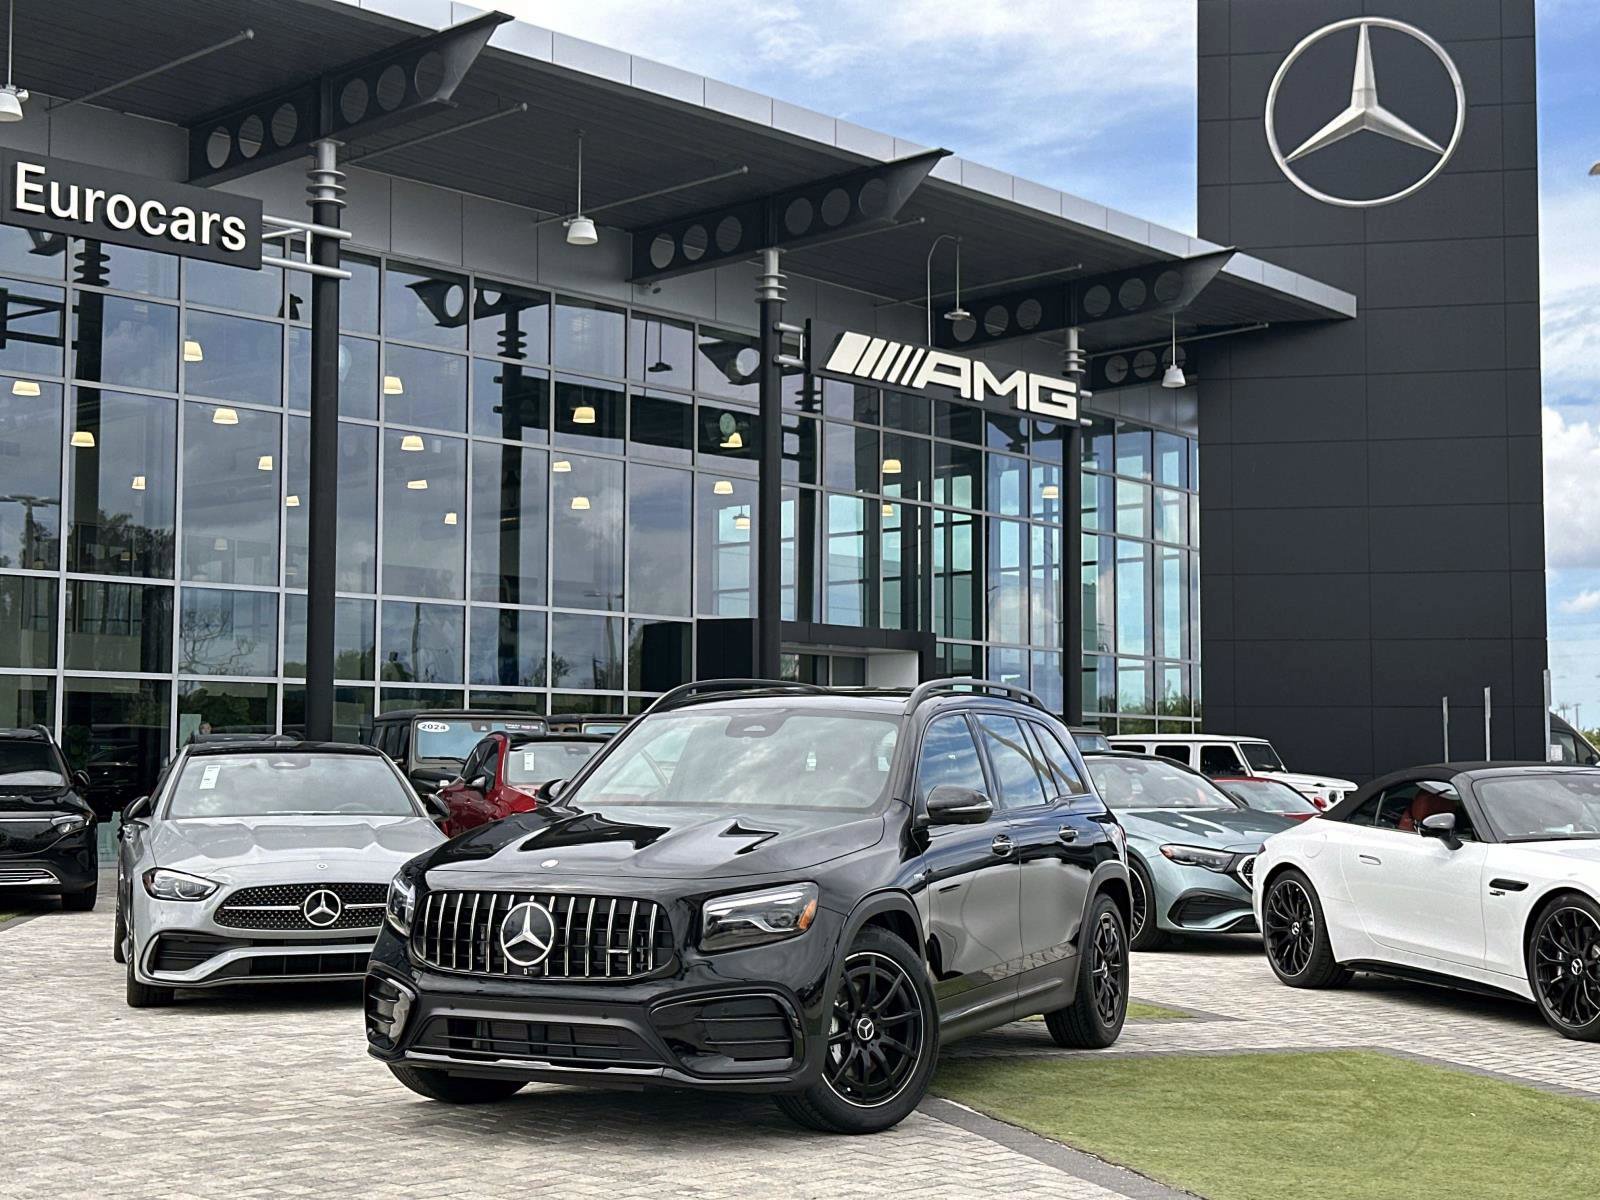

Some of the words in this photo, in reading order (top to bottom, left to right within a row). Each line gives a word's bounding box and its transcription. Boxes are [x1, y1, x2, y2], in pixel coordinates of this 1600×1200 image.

[16, 161, 247, 251] Eurocars
[911, 350, 1077, 420] AMG
[421, 723, 447, 731] 2024
